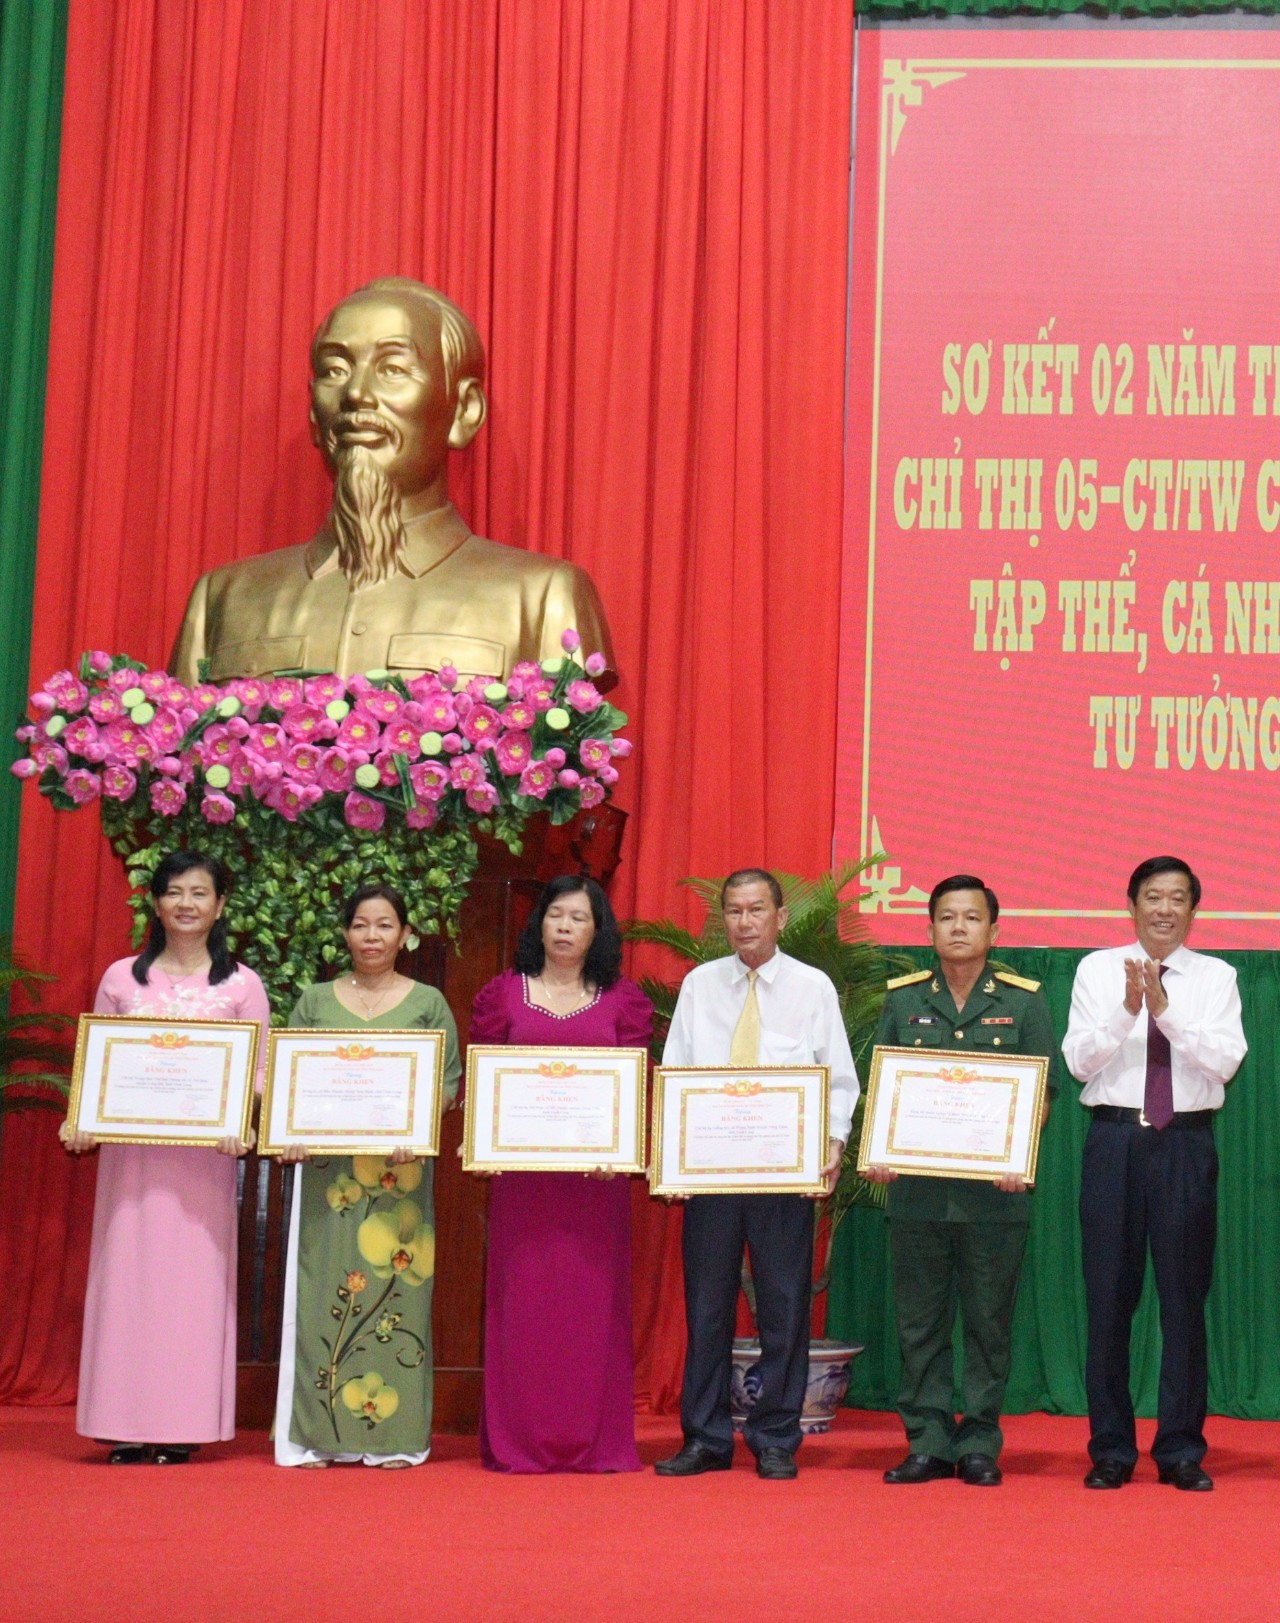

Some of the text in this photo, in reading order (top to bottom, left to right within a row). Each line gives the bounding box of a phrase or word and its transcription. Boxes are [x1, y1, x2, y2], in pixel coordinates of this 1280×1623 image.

[941, 340, 993, 416] SƠ
[1002, 317, 1080, 415] KẾT
[1091, 344, 1134, 415] 02
[1146, 329, 1237, 416] NĂM
[894, 437, 964, 530] CHỈ
[975, 458, 1044, 547] THỊ
[1055, 458, 1246, 532] 05-CT/TW
[969, 563, 1047, 670] TẬP
[1058, 549, 1148, 673] THỂ,
[1162, 564, 1213, 653] CÁ
[1089, 695, 1141, 769] TƯ
